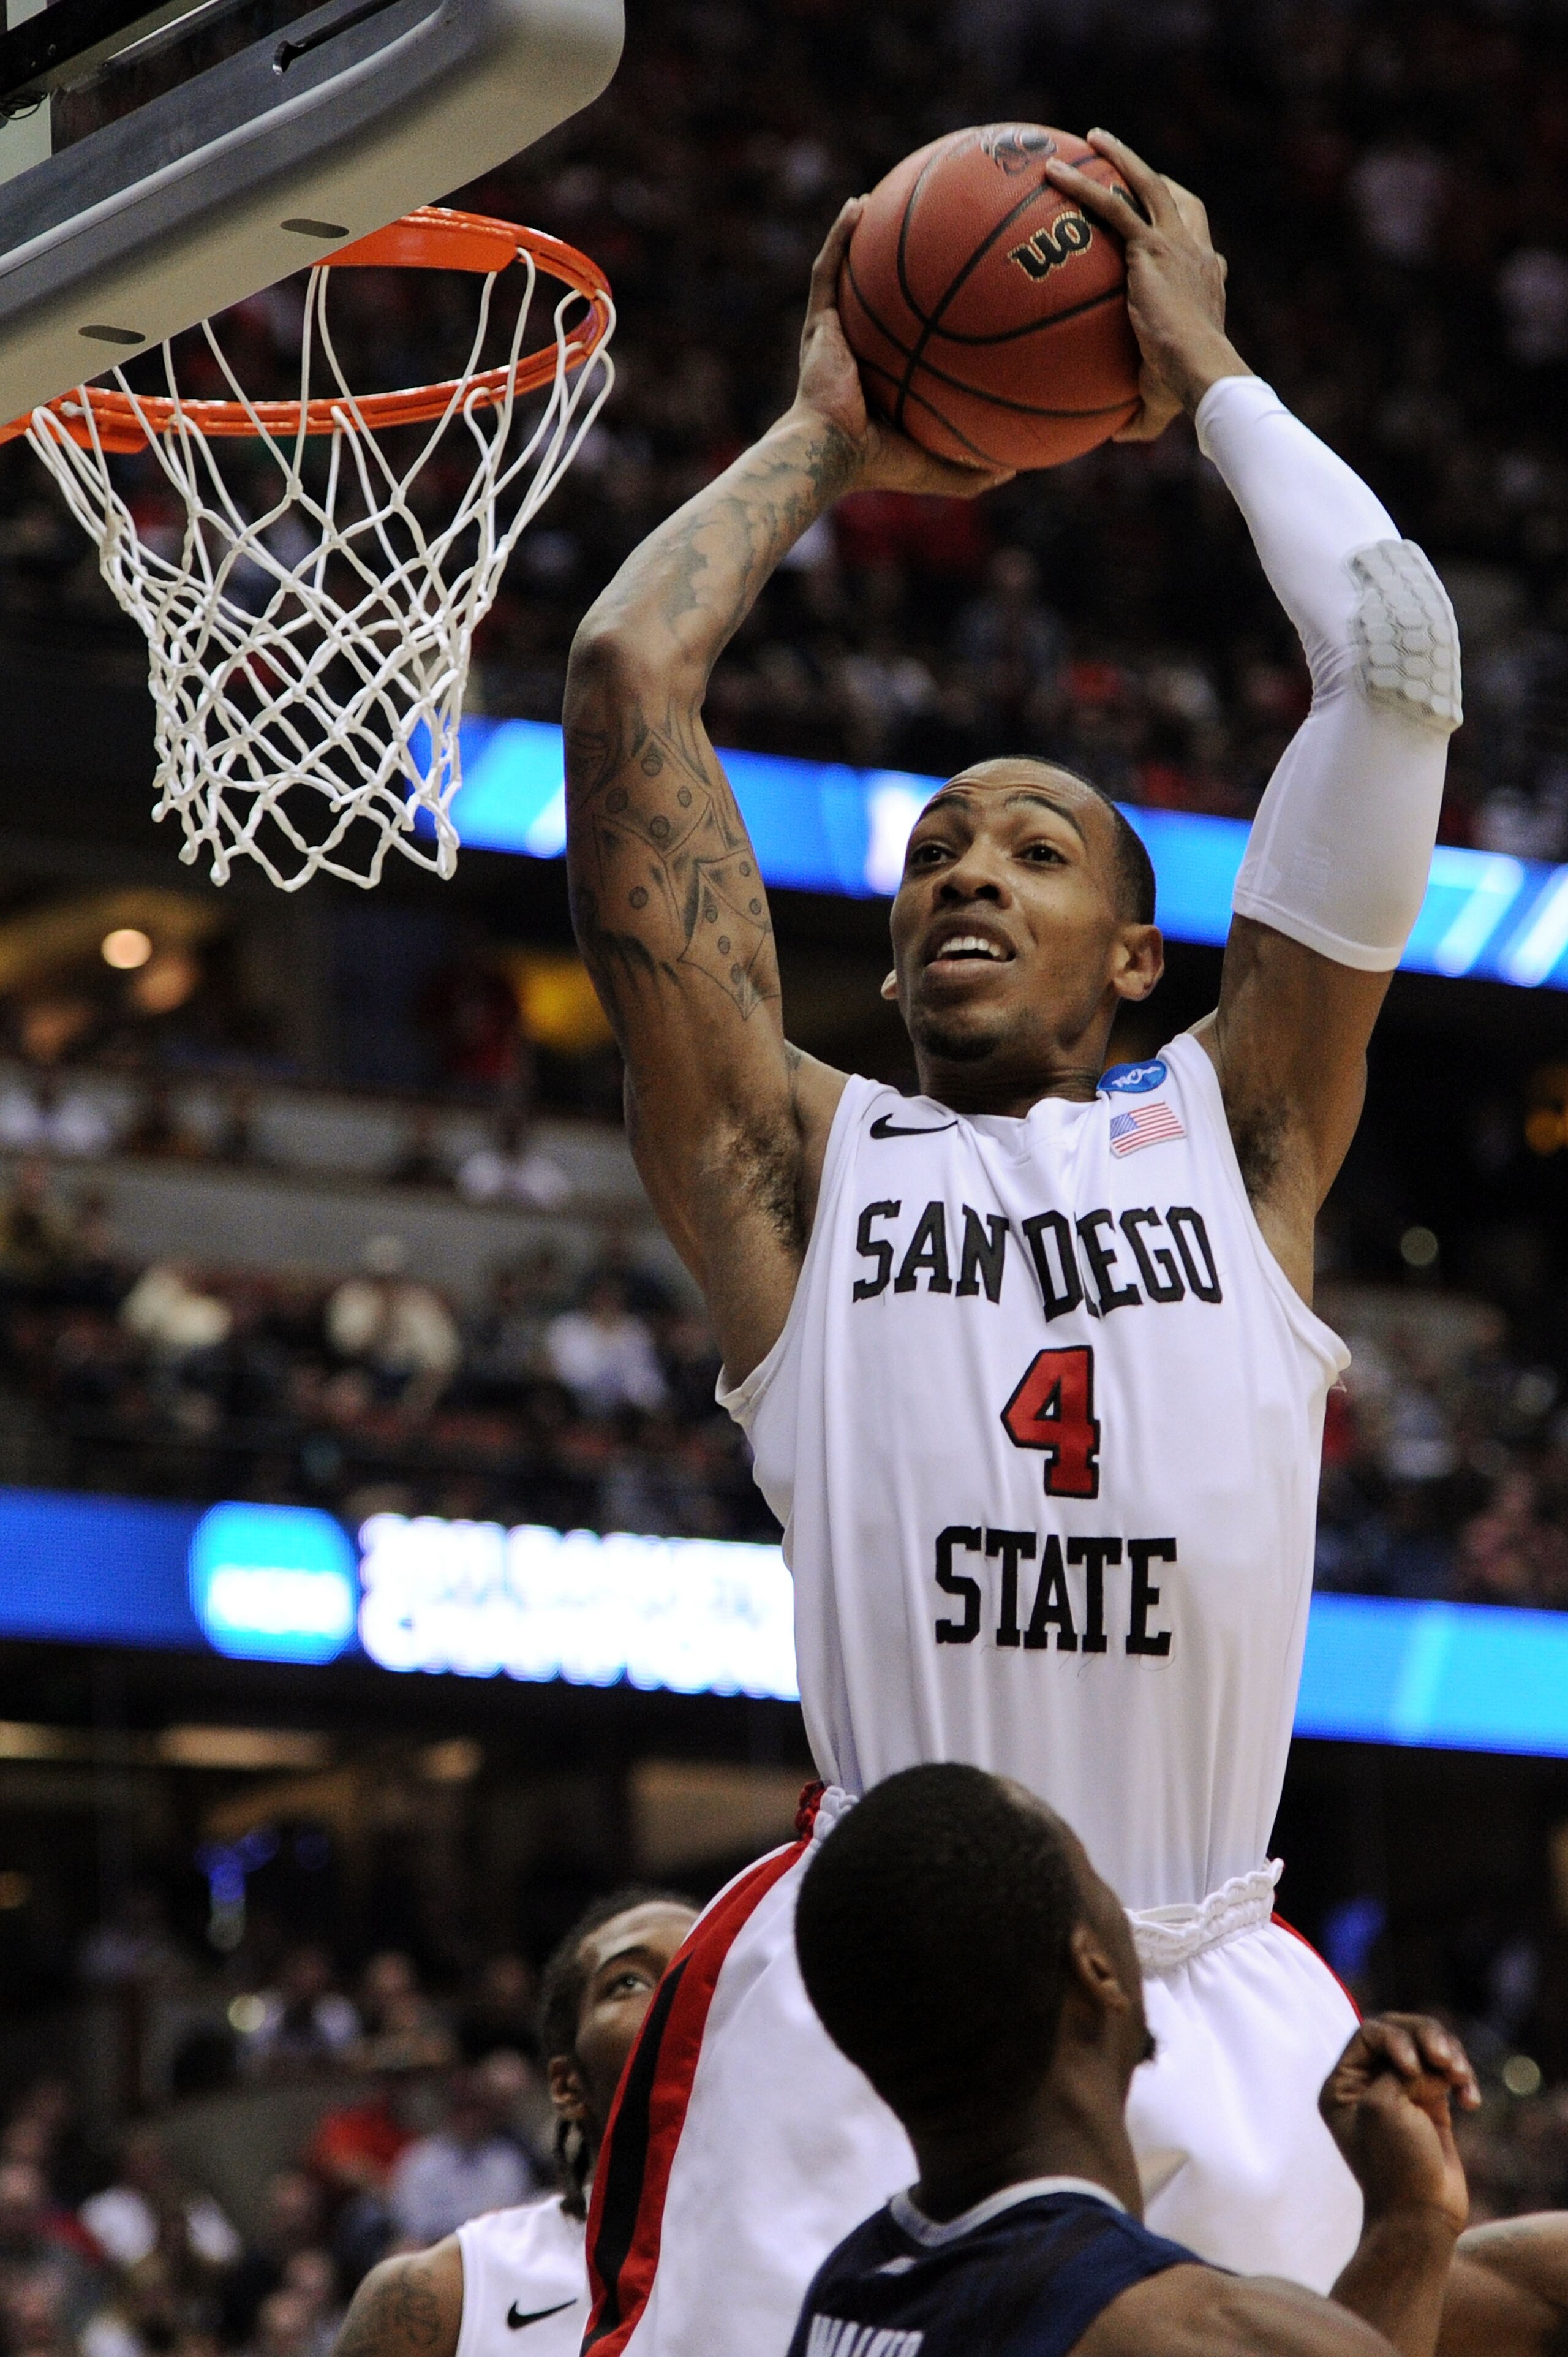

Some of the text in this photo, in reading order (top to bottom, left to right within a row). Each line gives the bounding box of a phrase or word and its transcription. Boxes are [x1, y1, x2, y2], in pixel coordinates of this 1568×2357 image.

[853, 1199, 1010, 1305] SAN
[1000, 1344, 1101, 1499] 4
[935, 1526, 1177, 1656] STATE
